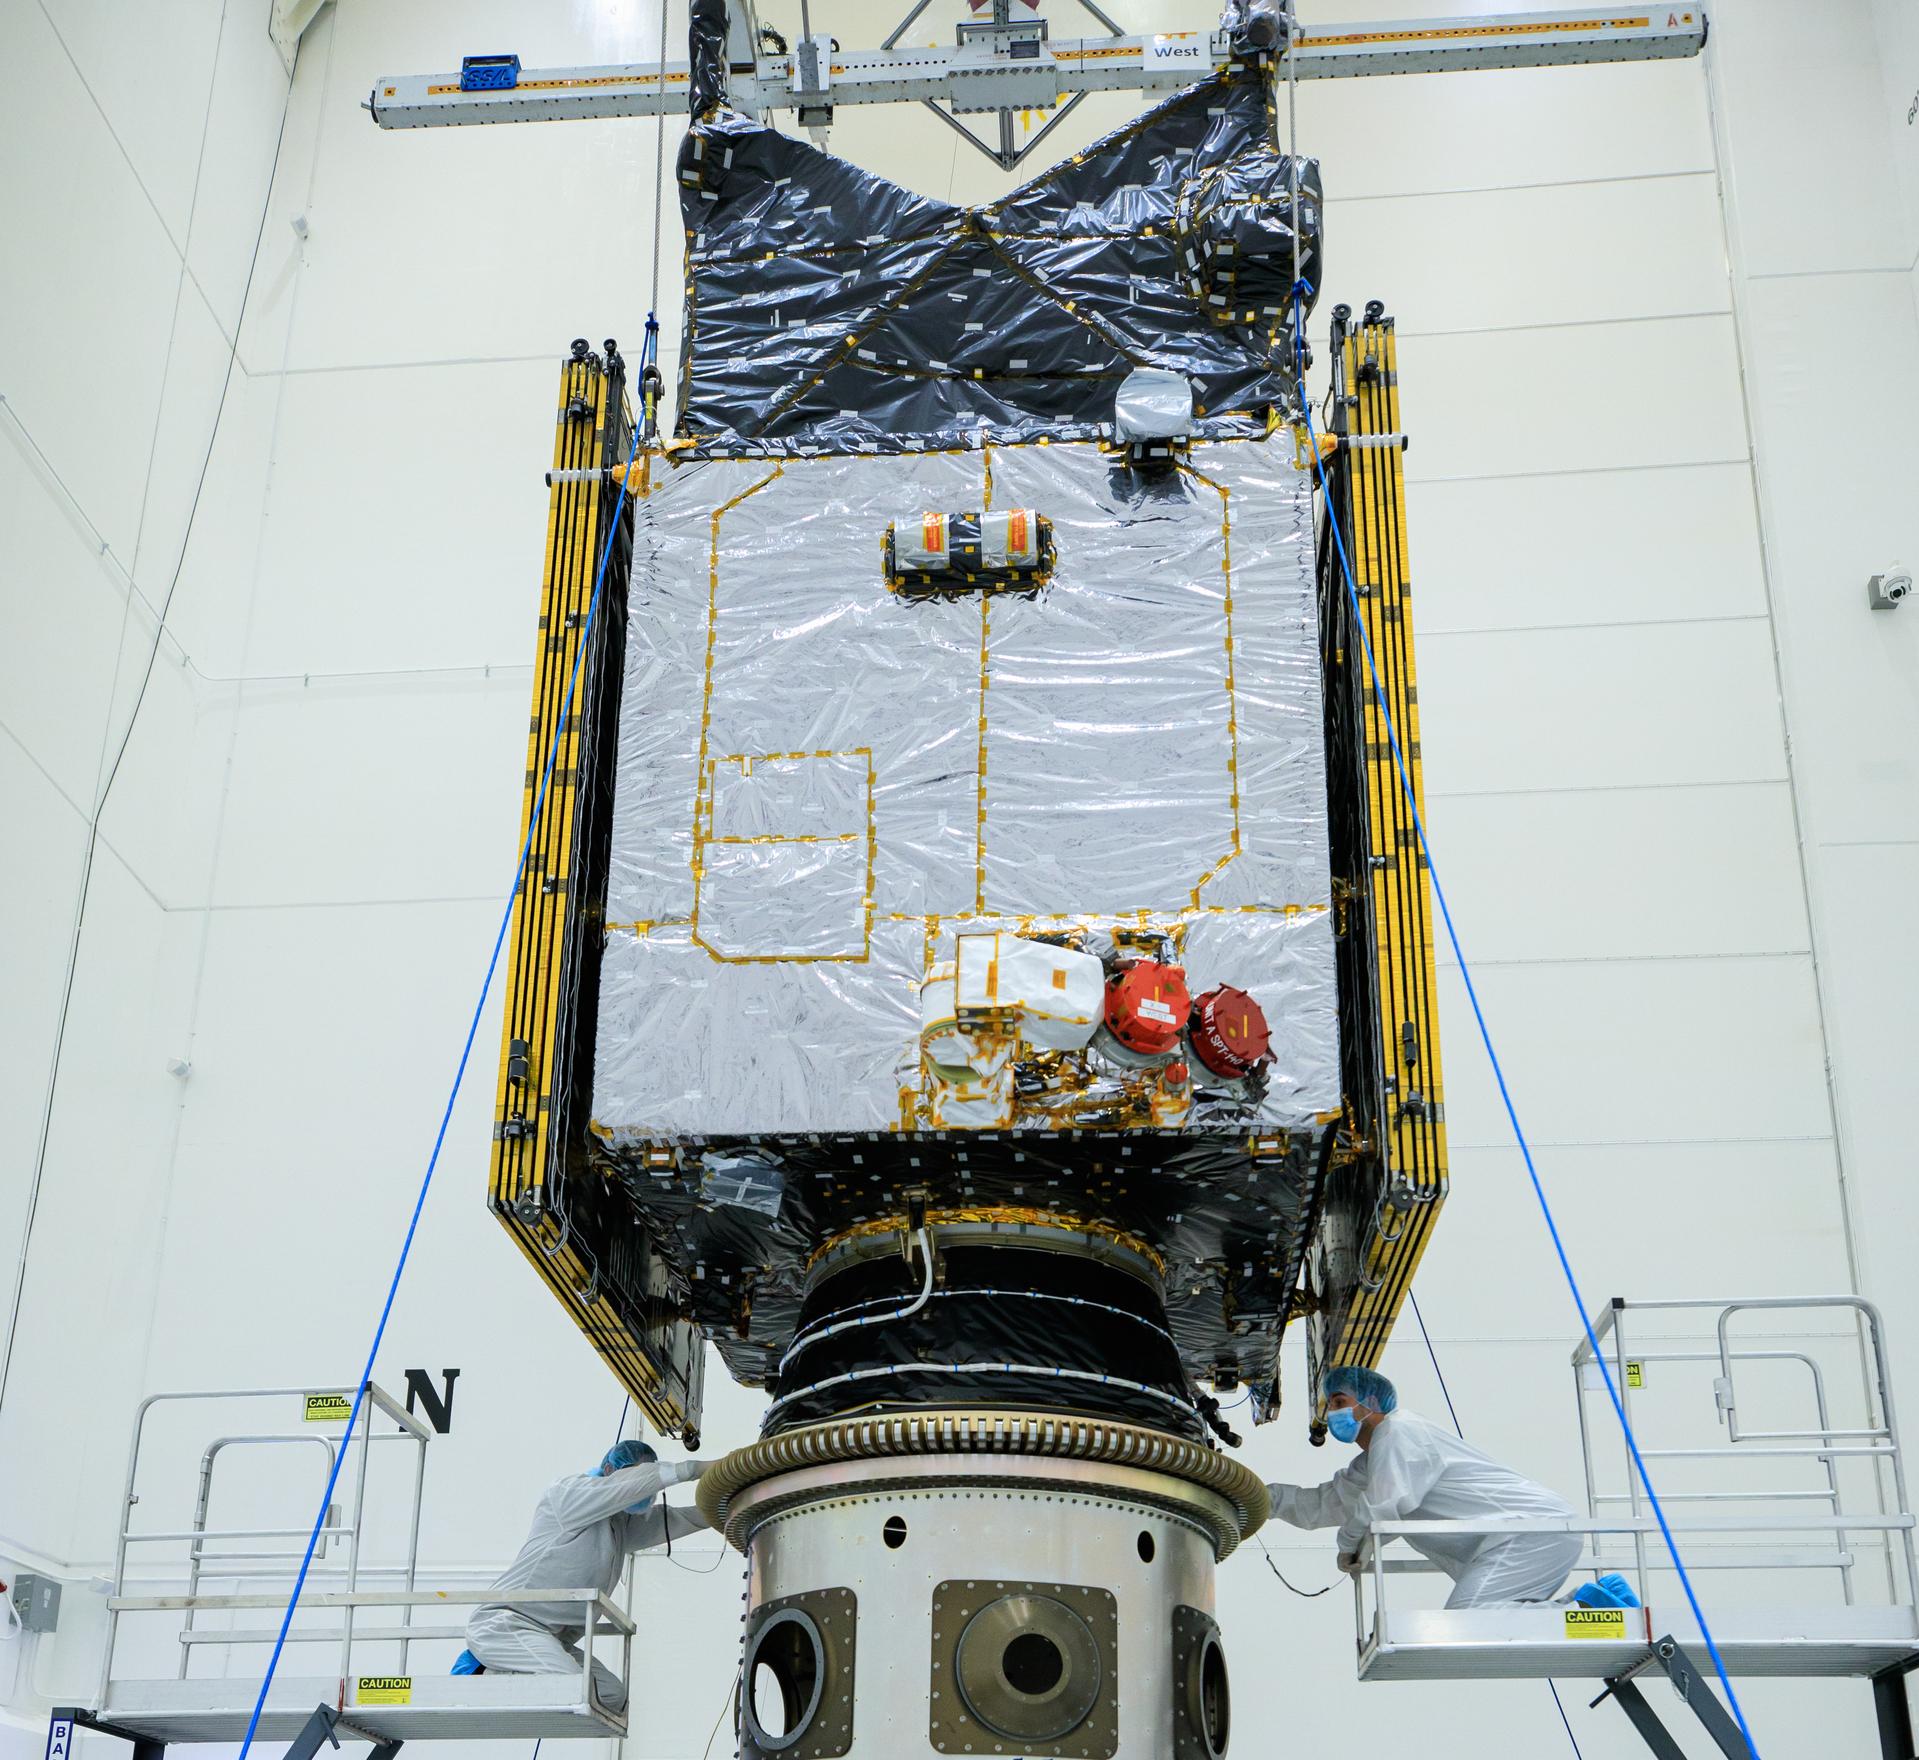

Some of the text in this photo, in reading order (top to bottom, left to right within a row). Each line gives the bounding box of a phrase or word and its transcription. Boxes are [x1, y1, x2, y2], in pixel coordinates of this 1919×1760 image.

[1667, 12, 1678, 27] A
[1154, 46, 1199, 58] West
[1210, 1034, 1244, 1065] SPT-140
[398, 1368, 461, 1434] N
[1567, 1612, 1622, 1622] CAUTION
[360, 1678, 410, 1689] CAUTION
